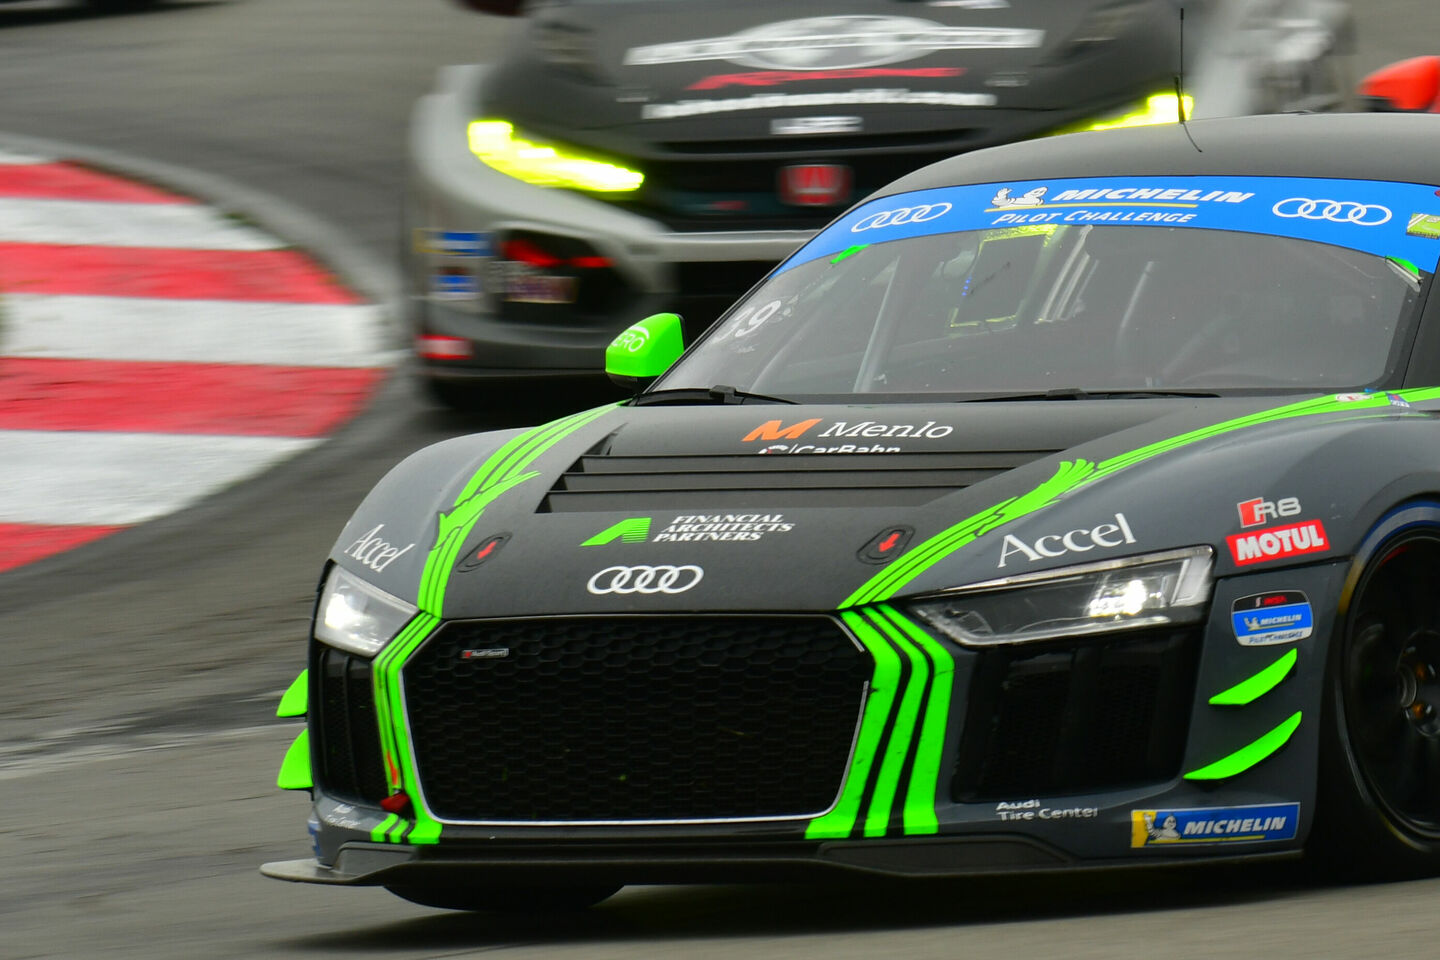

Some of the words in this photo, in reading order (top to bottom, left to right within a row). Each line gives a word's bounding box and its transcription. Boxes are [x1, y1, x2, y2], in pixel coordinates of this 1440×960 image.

[1050, 187, 1257, 204] MICHELIN
[991, 212, 1063, 226] PILOT
[1063, 210, 1199, 224] CHALLENGE
[817, 421, 954, 439] Menlo
[1253, 496, 1302, 522] R8
[660, 522, 797, 533] ARCHITECTS
[671, 514, 785, 524] FINANCIAL
[651, 531, 764, 543] PARTNERS
[997, 512, 1138, 569] Accel
[1235, 524, 1325, 562] MOTUL
[343, 523, 416, 574] Accel
[996, 799, 1040, 811] Audi
[996, 810, 1035, 821] Tire
[1038, 807, 1099, 820] Center
[1183, 816, 1287, 835] MICHELIN
